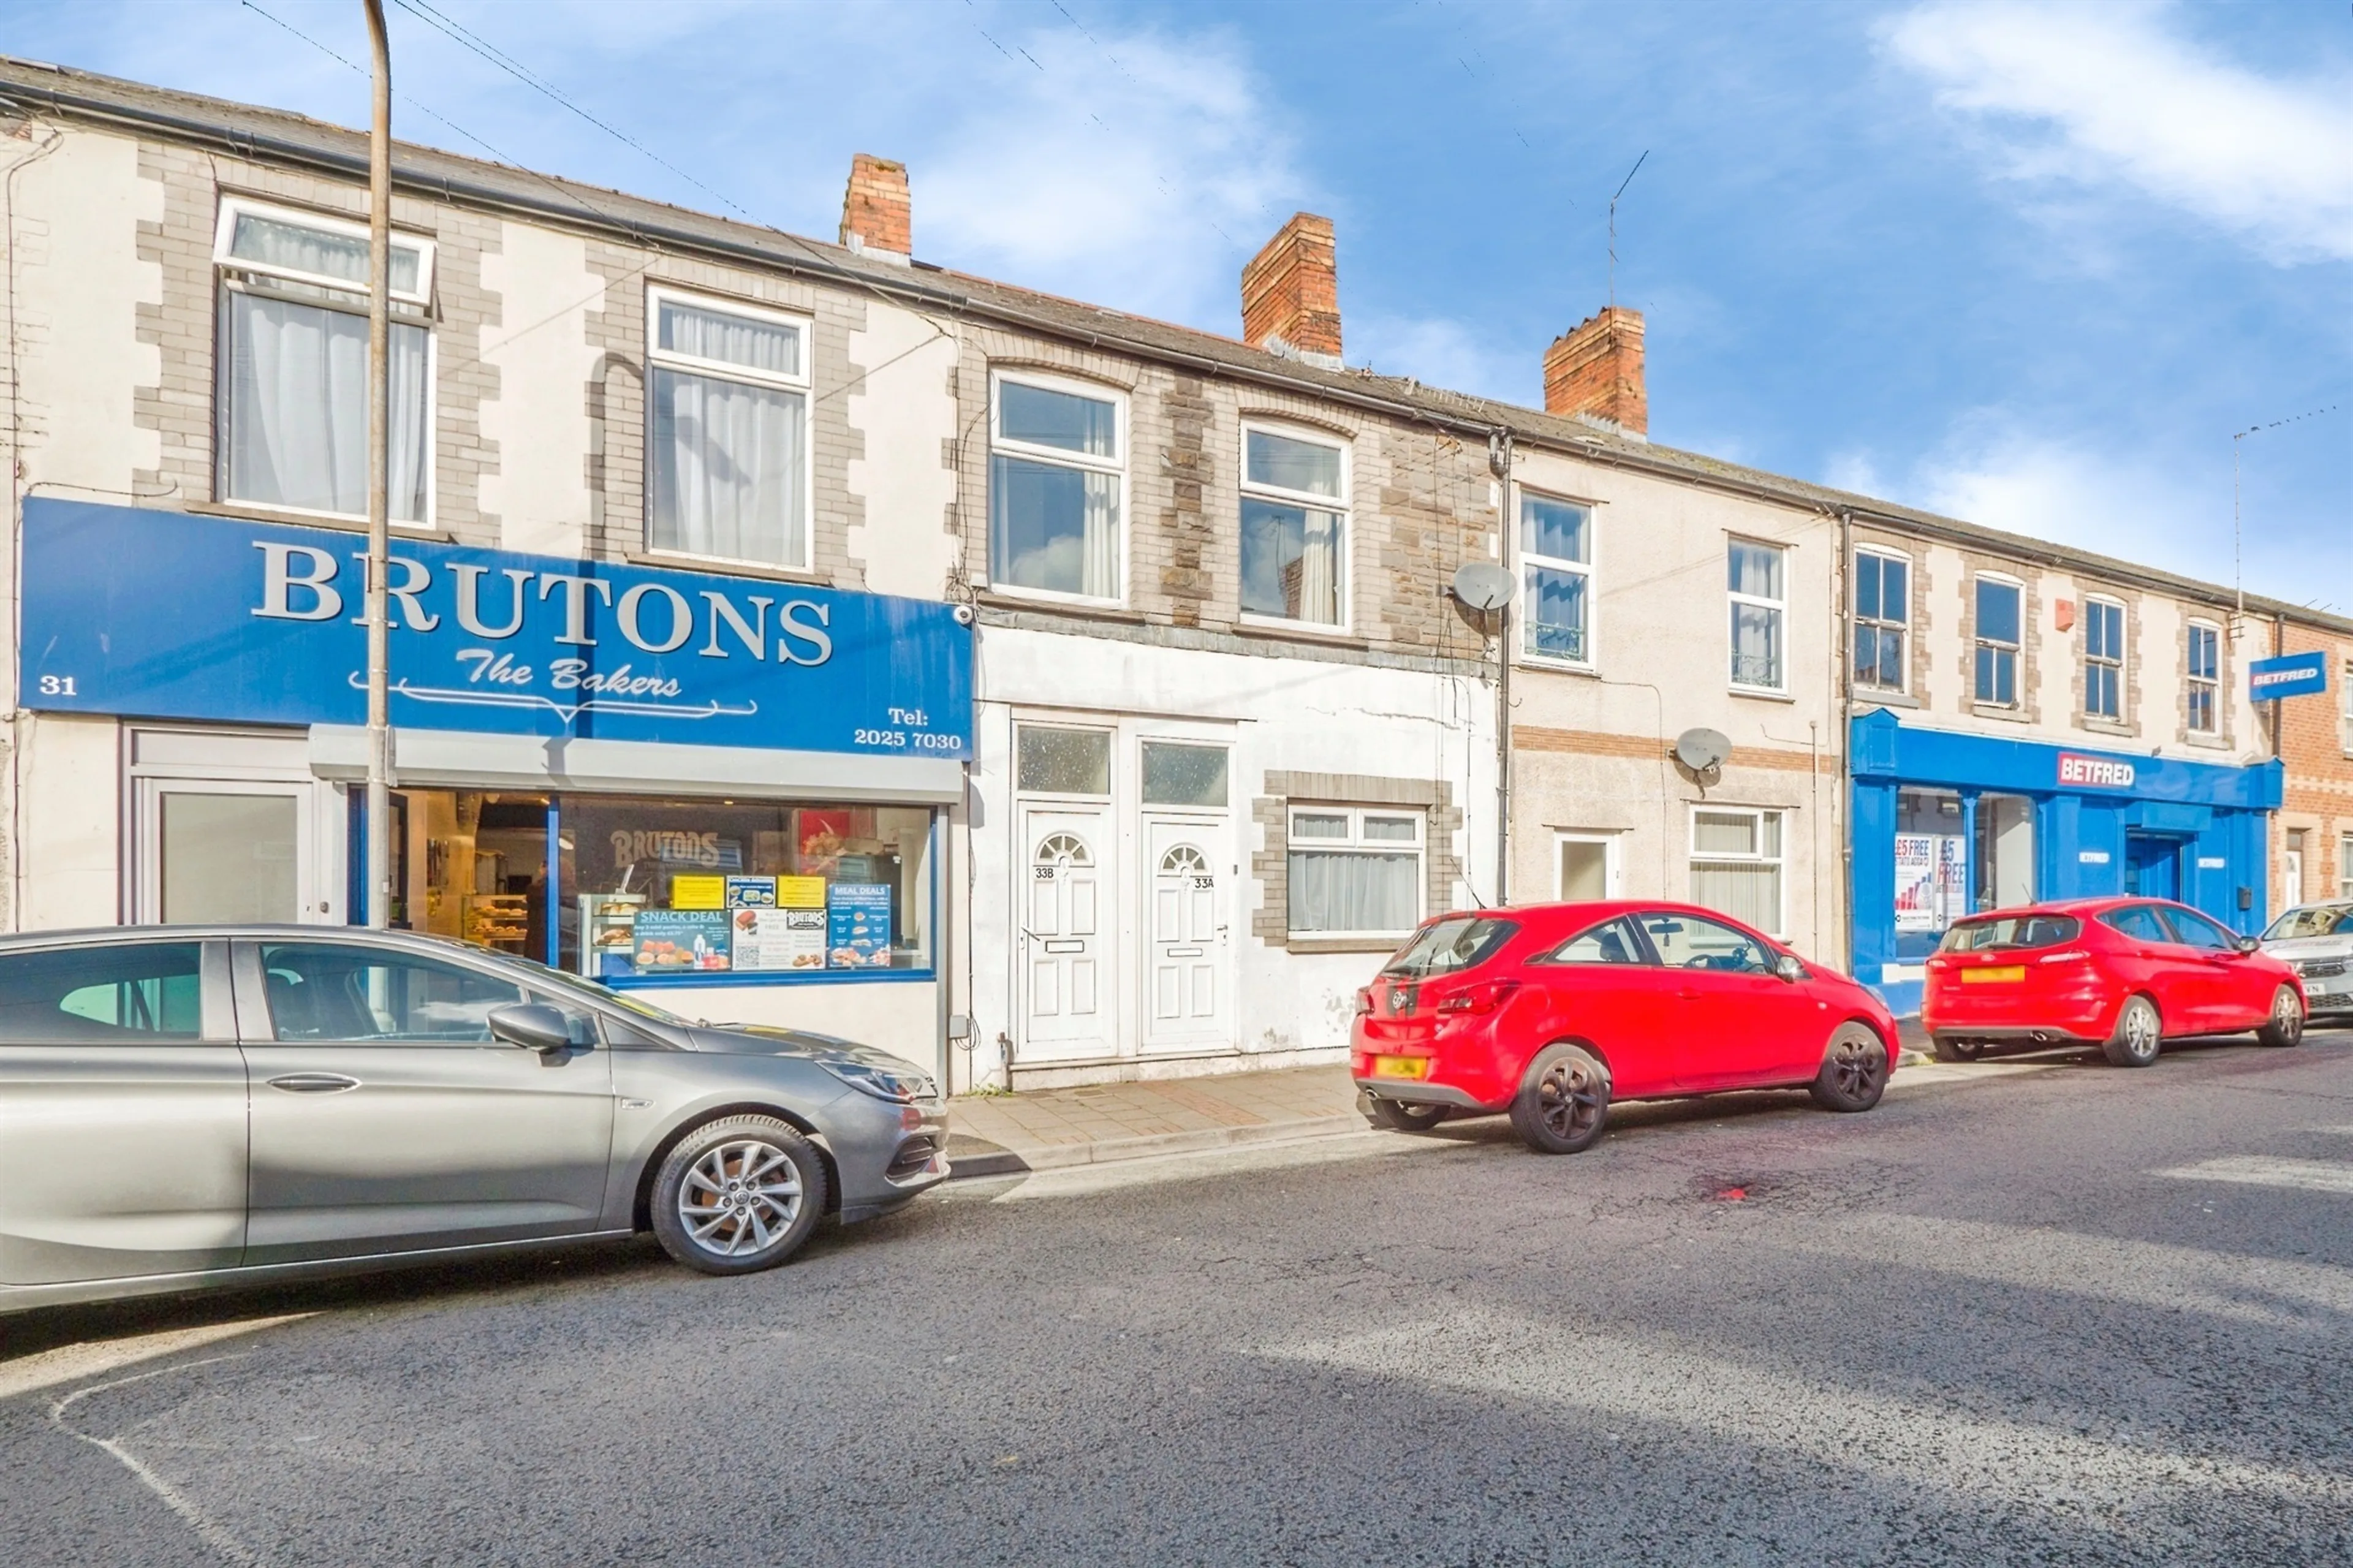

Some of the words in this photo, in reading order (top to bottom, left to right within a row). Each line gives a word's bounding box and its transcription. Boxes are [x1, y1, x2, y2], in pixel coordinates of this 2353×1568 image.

[251, 541, 832, 666] BRUTONS
[455, 648, 533, 684] The
[549, 658, 681, 697] Bakers
[2253, 668, 2318, 685] BETFRED
[39, 675, 77, 696] 31
[889, 708, 928, 725] Tel:
[854, 729, 905, 746] 2025
[912, 733, 961, 749] 7030
[2061, 758, 2135, 786] BETFRED
[1909, 839, 1929, 855] FREE
[1036, 868, 1054, 878] 33B
[1937, 863, 1964, 884] FREE
[1195, 879, 1214, 888] 33A
[640, 912, 685, 922] SNACK
[691, 912, 723, 922] DEAL
